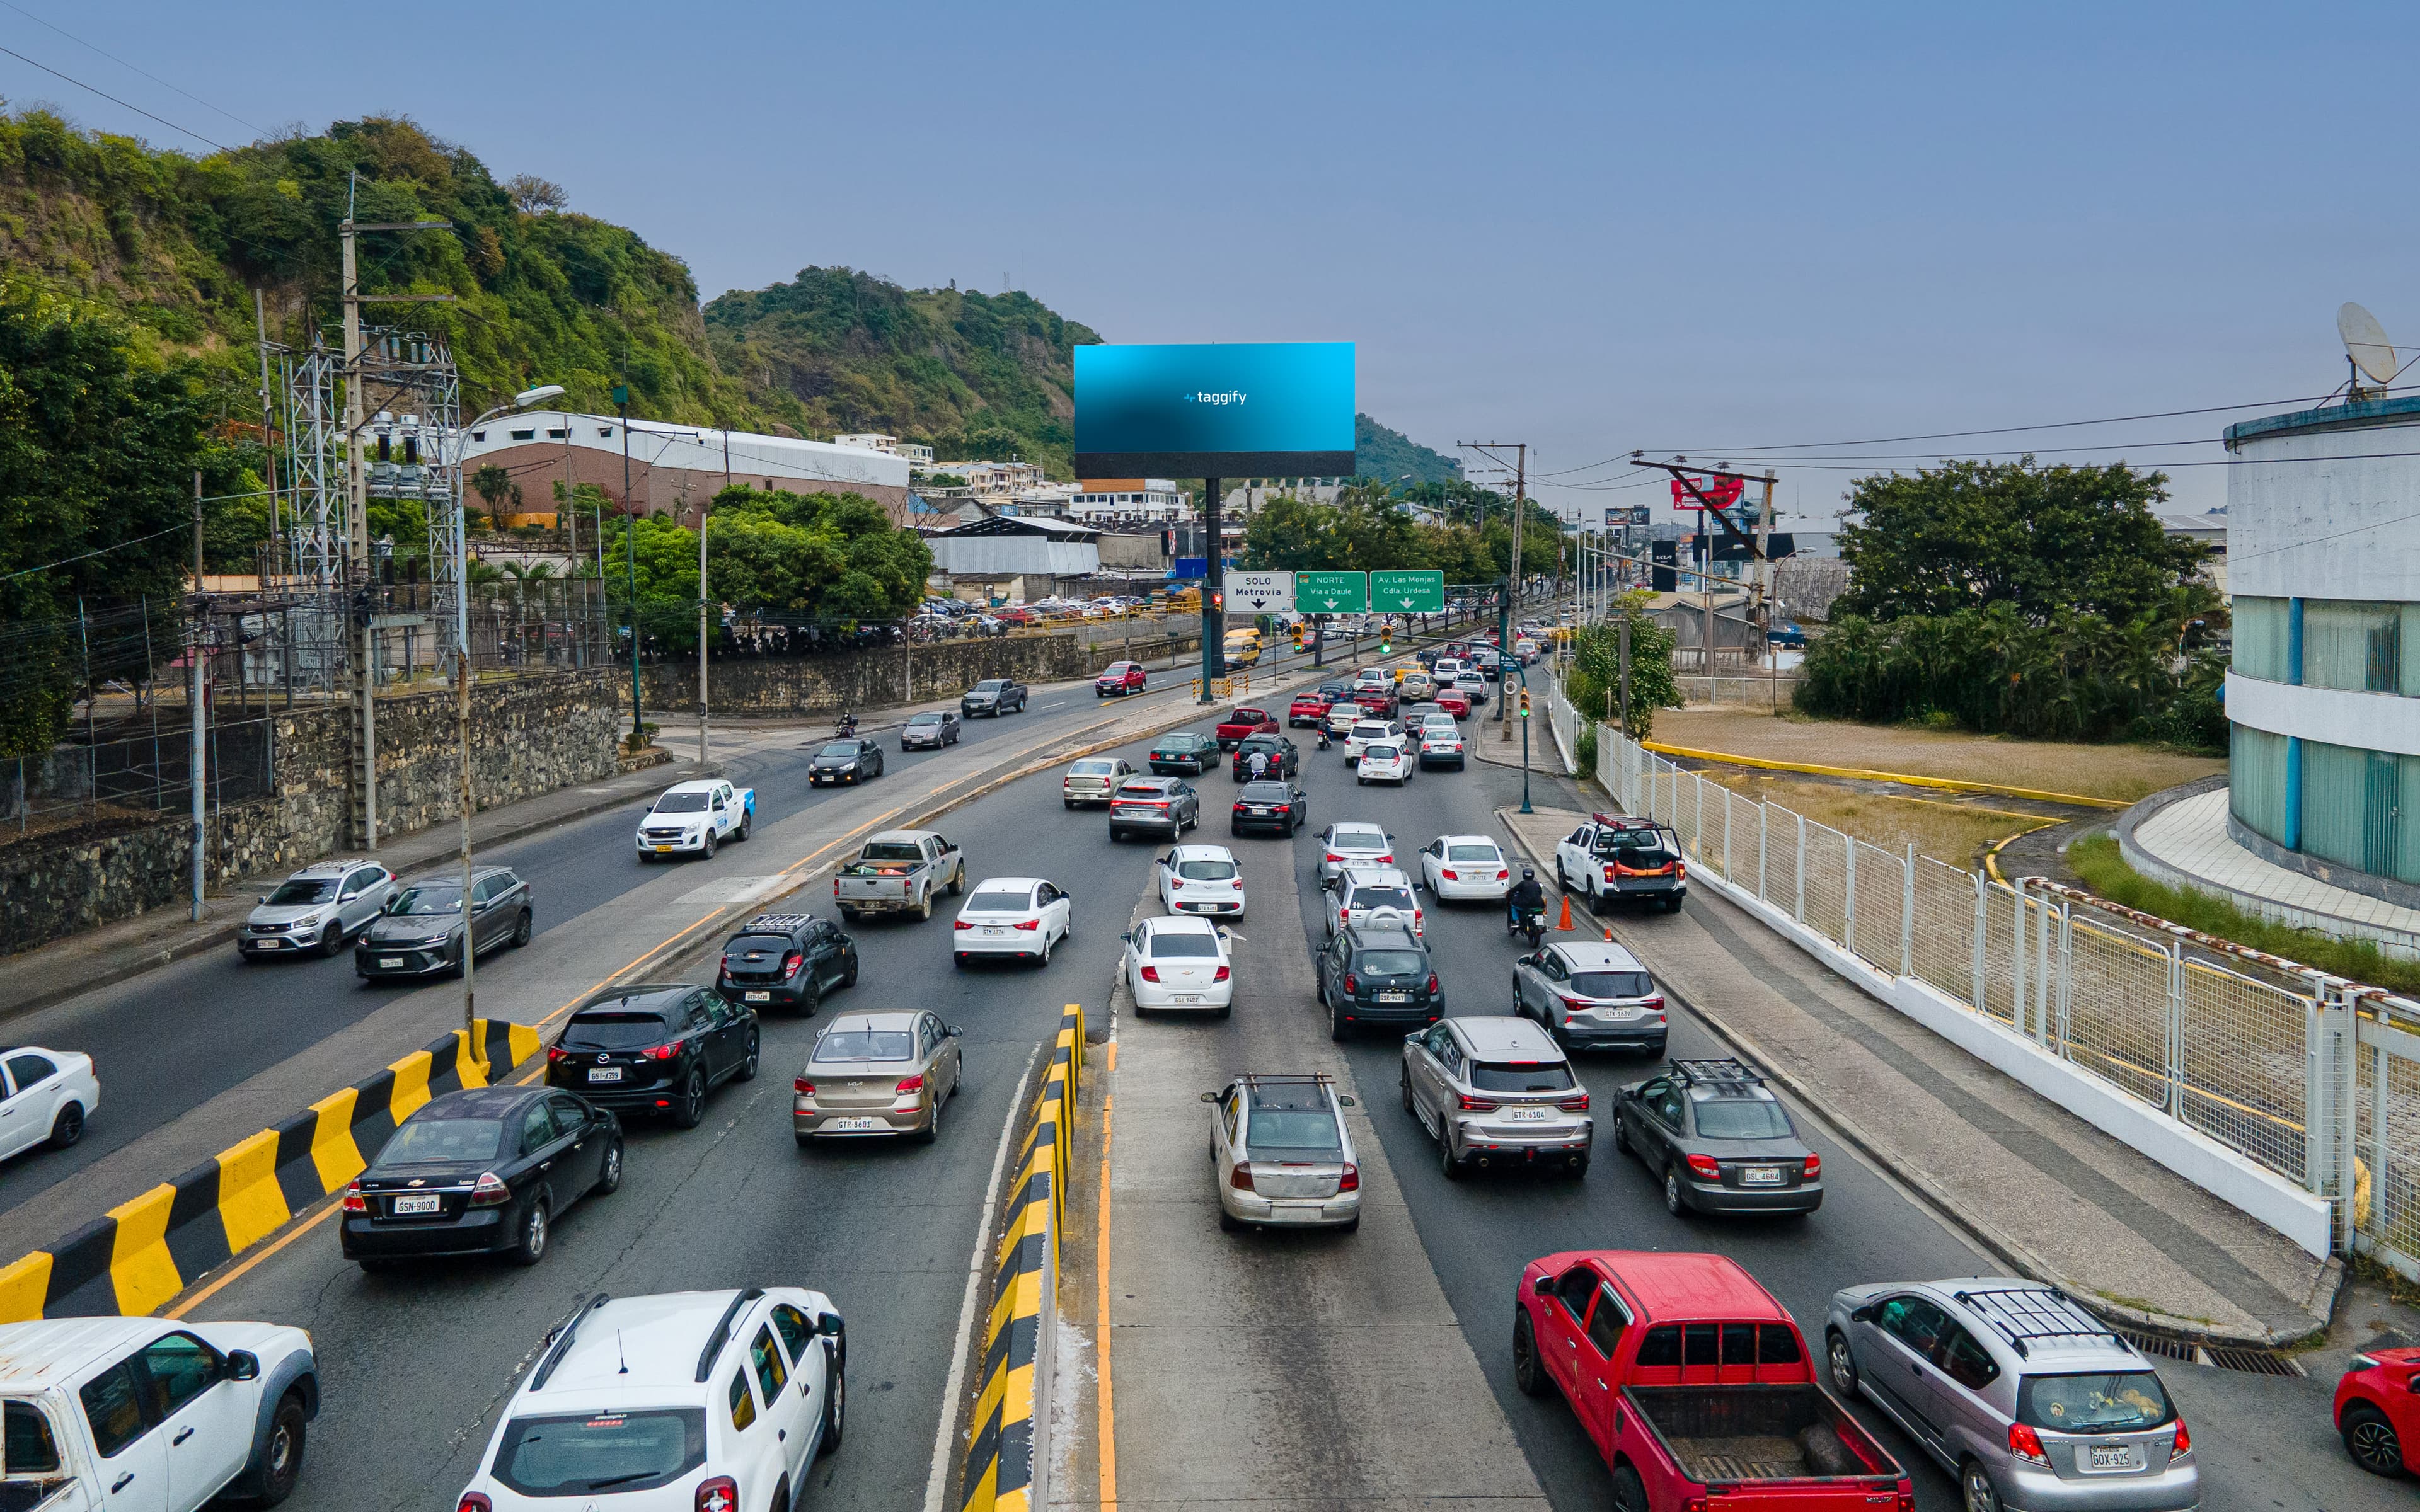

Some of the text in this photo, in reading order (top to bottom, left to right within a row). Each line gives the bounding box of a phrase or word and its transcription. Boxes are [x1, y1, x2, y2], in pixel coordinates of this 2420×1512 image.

[1197, 390, 1247, 405] taggify
[1409, 576, 1436, 584] Monjas
[2093, 1453, 2129, 1465] GOX-925
